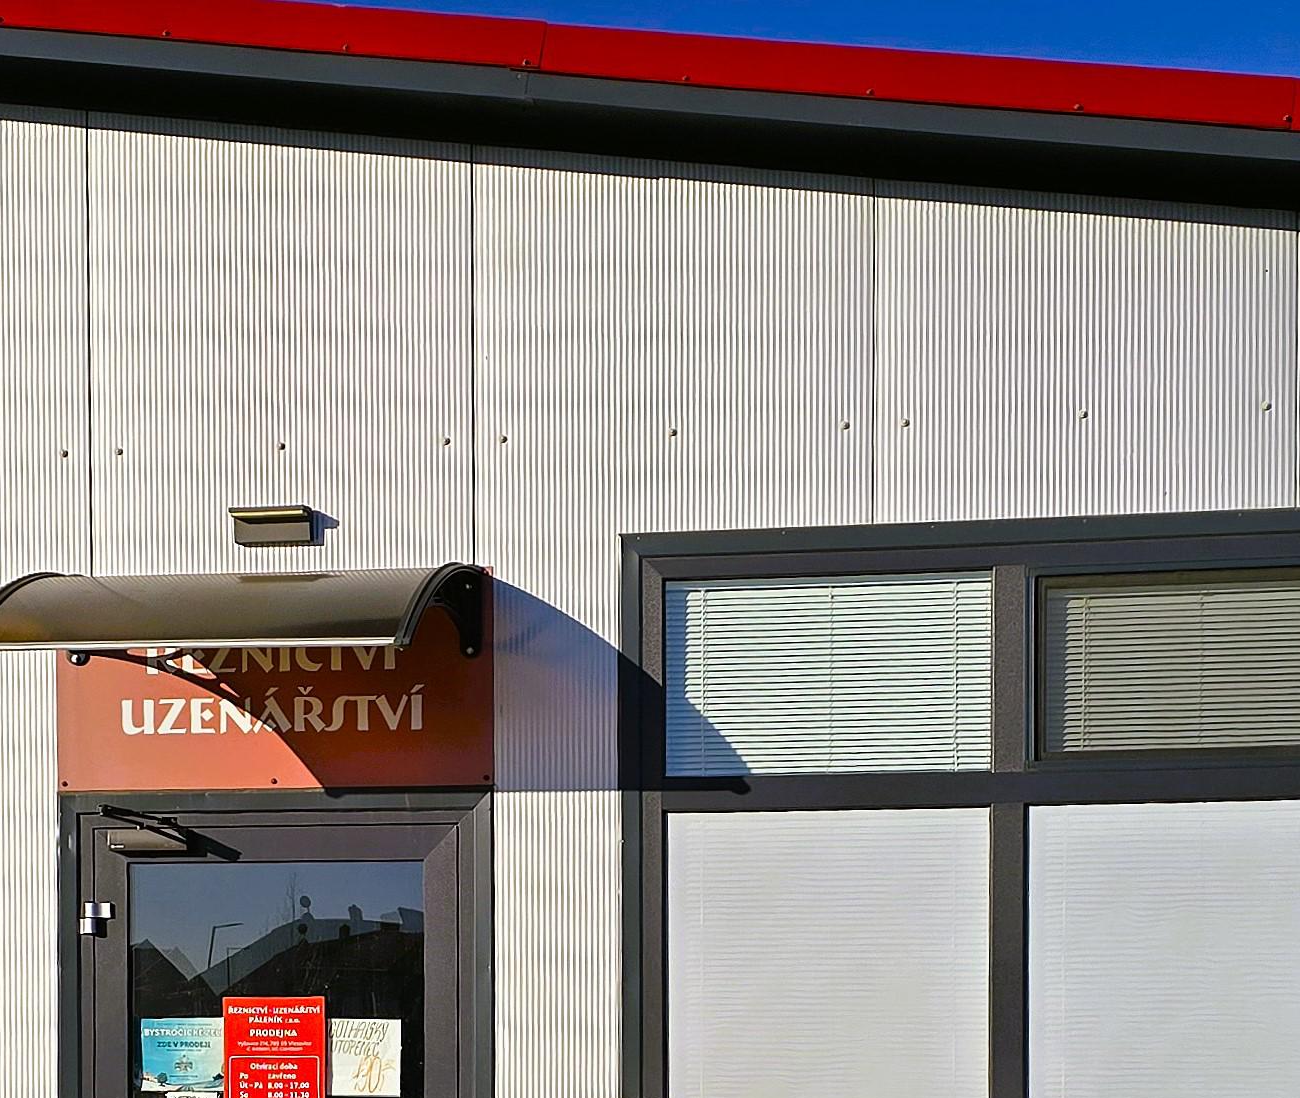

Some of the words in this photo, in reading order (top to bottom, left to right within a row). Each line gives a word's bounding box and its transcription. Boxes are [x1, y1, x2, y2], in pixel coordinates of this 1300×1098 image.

[120, 684, 426, 735] UZENÁŘSTVÍ
[249, 1029, 297, 1038] PRODEJNA
[279, 1062, 298, 1070] doba
